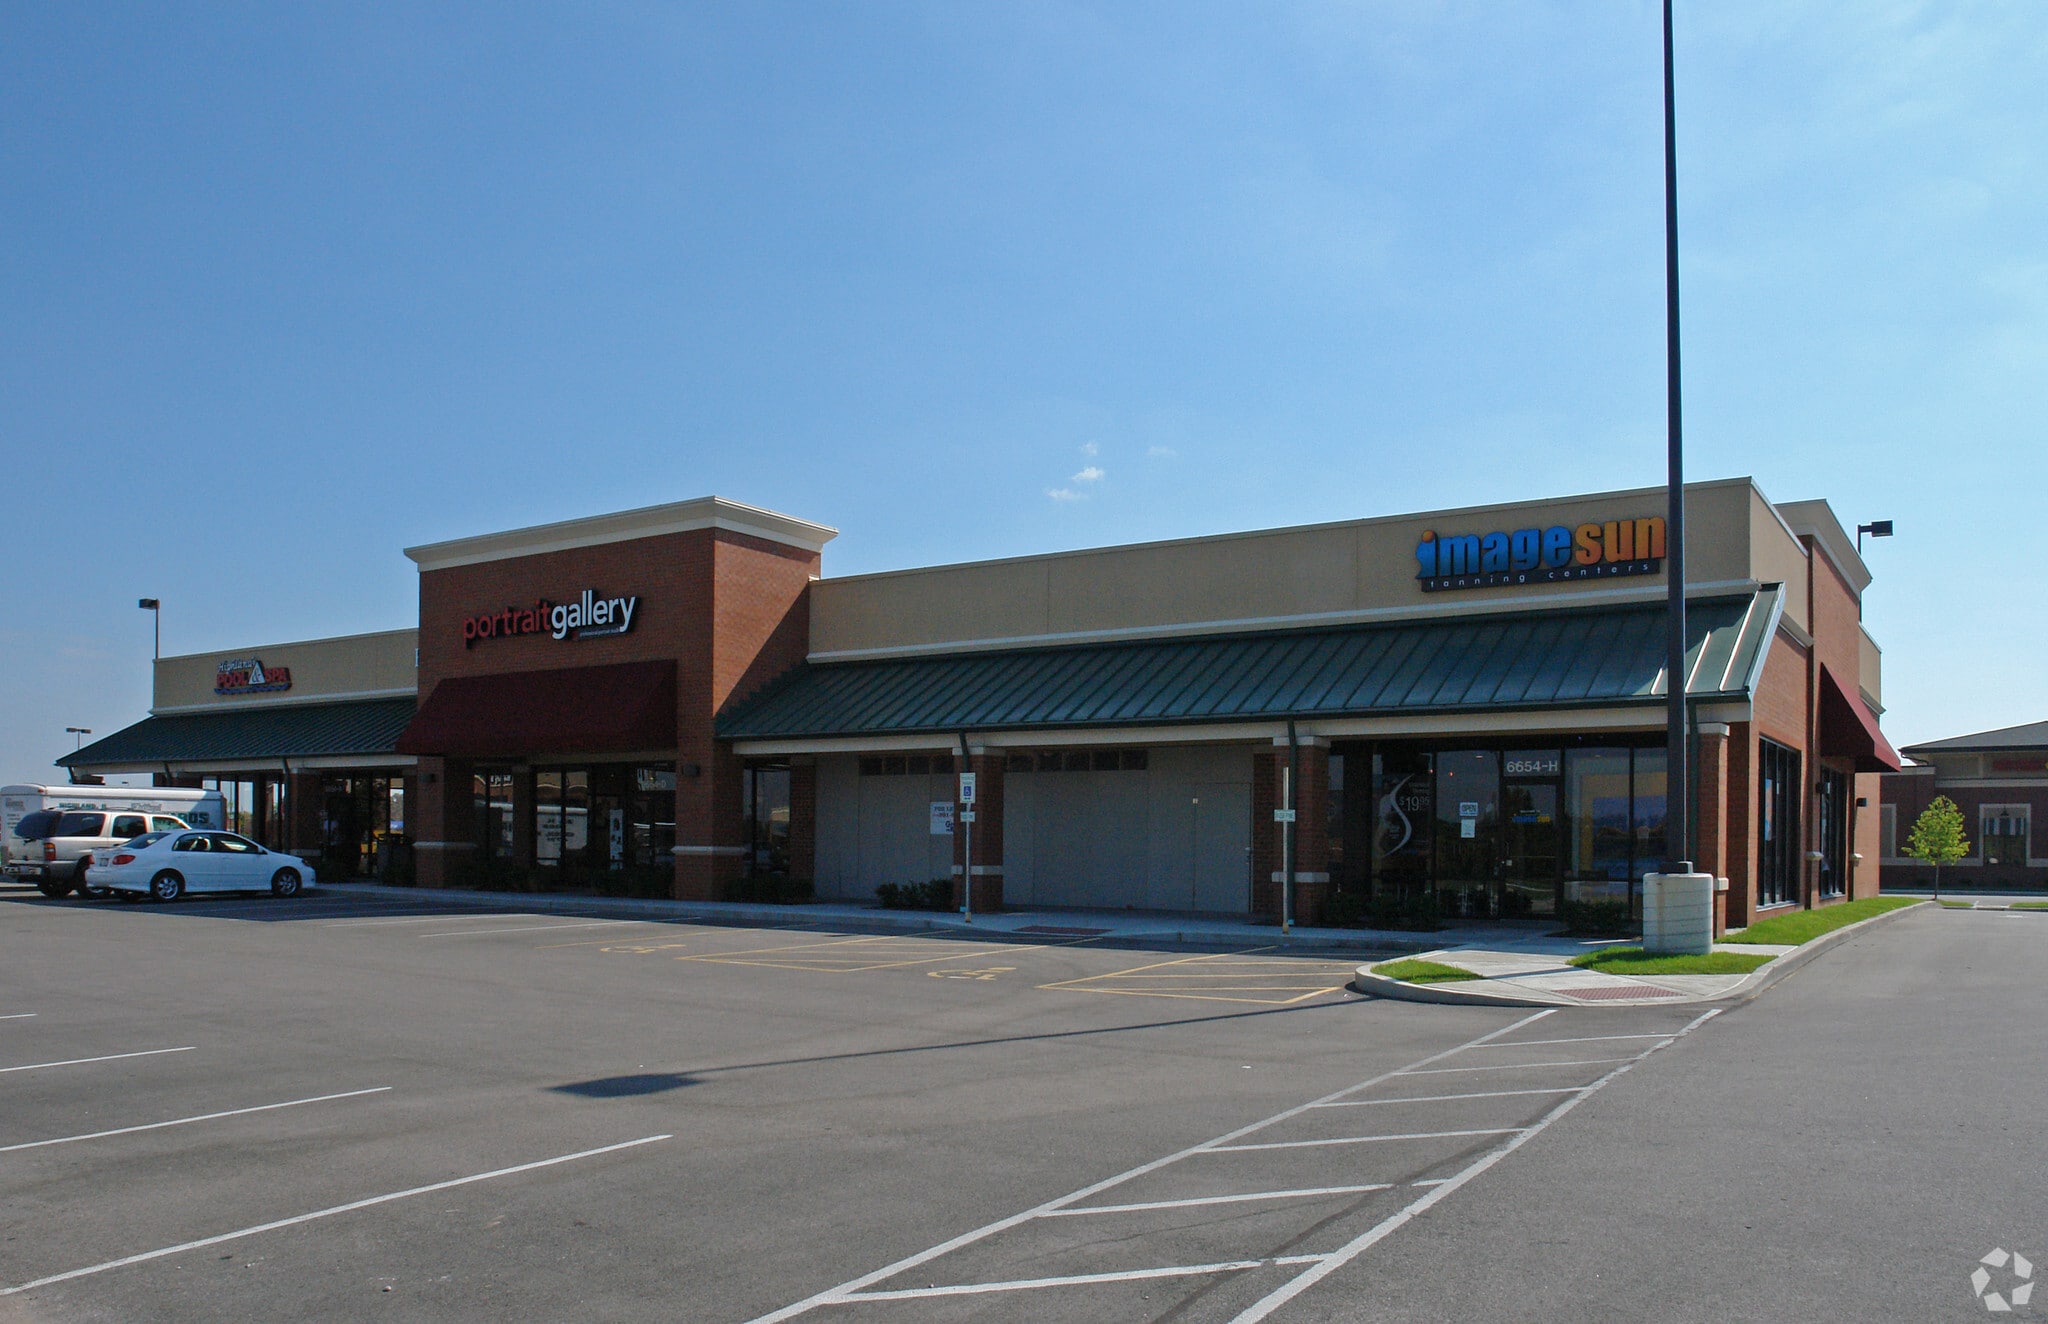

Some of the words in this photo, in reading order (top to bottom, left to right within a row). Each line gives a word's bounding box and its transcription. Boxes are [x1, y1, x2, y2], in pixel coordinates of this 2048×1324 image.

[1415, 516, 1666, 579] imagesun
[1430, 574, 1526, 588] tanning
[1548, 562, 1649, 579] centers
[463, 589, 636, 649] portraitgallery
[217, 671, 246, 688] POOL
[264, 667, 287, 682] SPA
[1506, 760, 1558, 773] 6654-H
